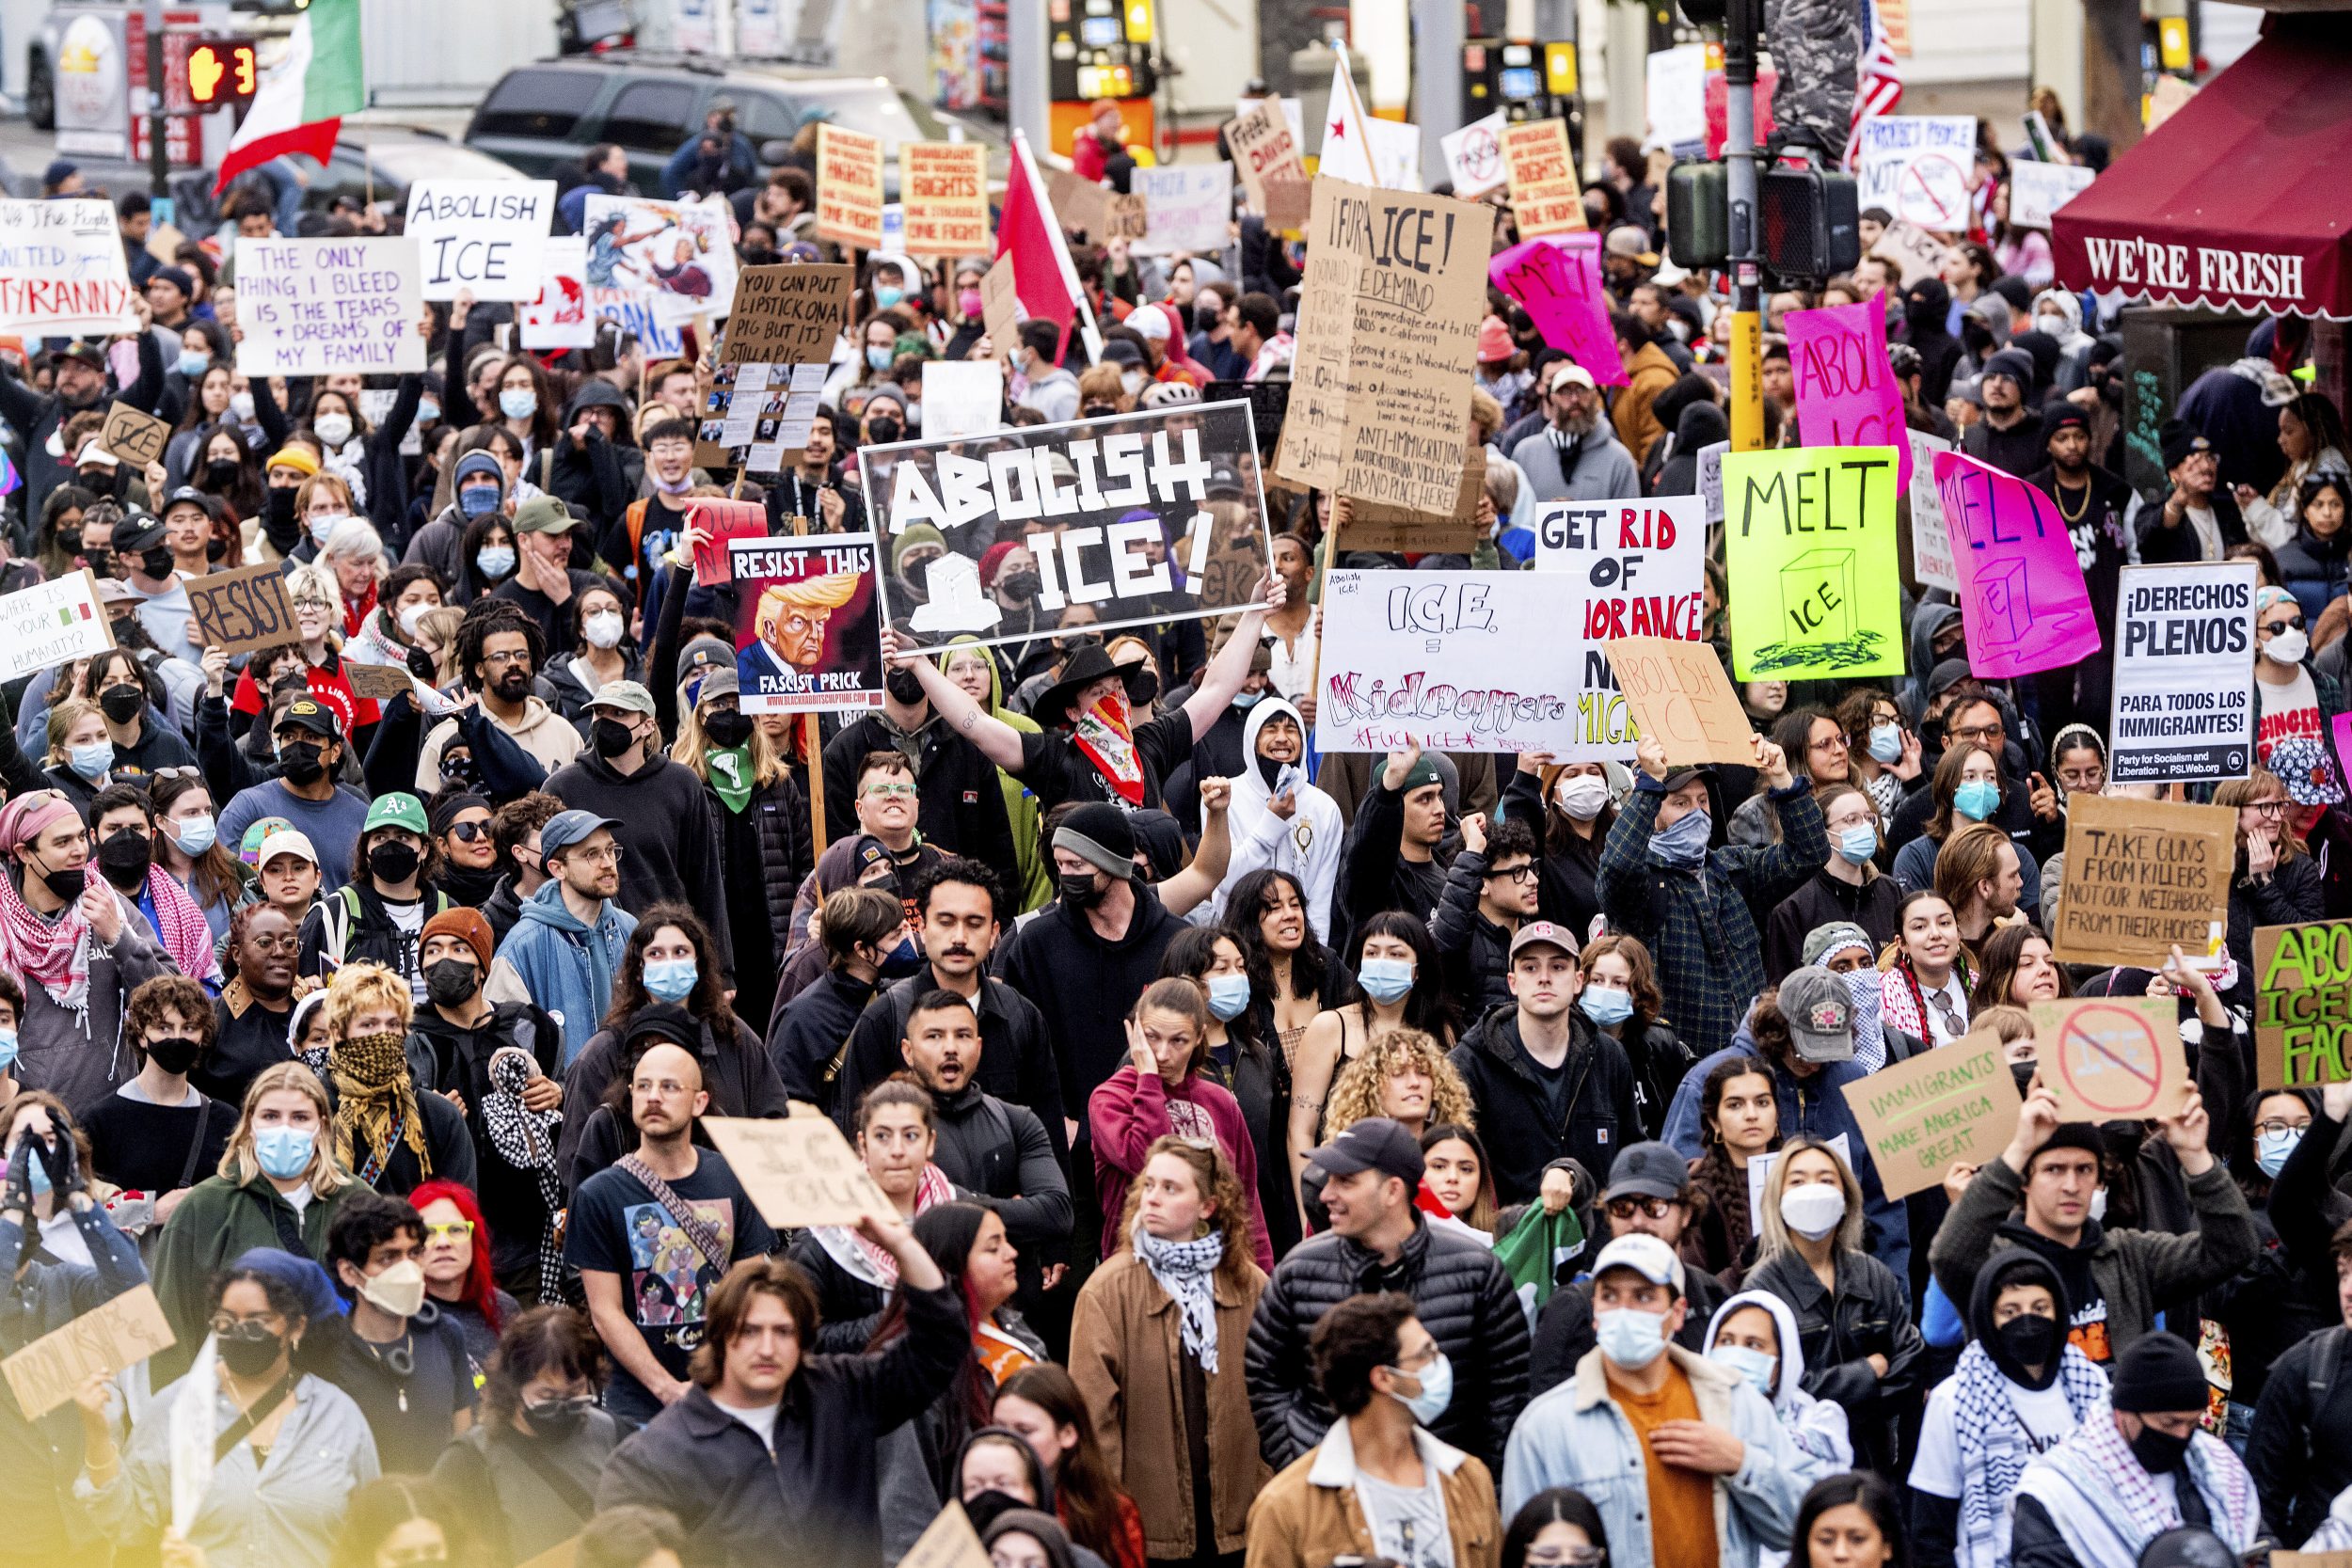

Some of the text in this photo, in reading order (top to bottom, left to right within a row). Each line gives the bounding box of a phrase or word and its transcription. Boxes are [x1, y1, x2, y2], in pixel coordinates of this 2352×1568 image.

[234, 47, 254, 93] 3
[912, 176, 977, 198] RIGHTS
[1865, 158, 1905, 197] NOT
[412, 191, 537, 223] ABOLISH
[255, 246, 366, 270] THE ONLY
[430, 236, 512, 284] ICE
[2084, 235, 2305, 299] WE'RE FRESH
[0, 277, 126, 314] TYRANNY
[238, 271, 401, 298] THING I BLEED
[744, 275, 841, 294] YOU CAN PUT
[1374, 268, 1435, 313] DEMAND
[256, 297, 401, 322] IS THE TEARS
[739, 296, 837, 323] LIPSTICK ON A
[1371, 306, 1479, 339] immediate end to ICE
[293, 321, 408, 341] DREAMS OF
[736, 320, 759, 338] PIG
[764, 321, 794, 340] BUT
[1390, 325, 1438, 346] California
[276, 341, 396, 367] MY FAMILY
[729, 342, 805, 362] STILL A PIG
[1377, 381, 1437, 404] Accountability
[114, 420, 162, 460] ICE
[1357, 426, 1463, 466] ANTI-IMMIGRATION
[888, 428, 1212, 534] ABOLISH
[1344, 468, 1454, 511] HAS NO PLACE HERE!
[1417, 464, 1457, 488] VIOLENCE
[1742, 460, 1889, 536] MELT
[1541, 508, 1677, 550] GET RID
[734, 547, 871, 578] RESIST THIS
[1589, 555, 1644, 591] OF
[44, 585, 65, 605] IS
[188, 570, 294, 646] RESIST
[1388, 583, 1499, 634] I.C.E.
[1789, 581, 1842, 635] ICE
[2127, 583, 2249, 618] ¡DERECHOS
[13, 611, 53, 638] YOUR
[2124, 616, 2248, 657] PLENOS
[11, 630, 86, 672] HUMANITY?
[759, 671, 862, 694] FASCIST PRICK
[1616, 656, 1719, 700] ABOLISH
[766, 692, 866, 706] WWW.BLACKRABBITSCULPTURE.COM
[1326, 671, 1566, 734] Kidnappers
[2120, 690, 2246, 713] PARA TODOS LOS
[1637, 697, 1730, 746] ICE
[2119, 713, 2244, 737] INMIGRANTES!
[2117, 763, 2219, 777] Liberation PSLWeb.org
[2118, 751, 2209, 768] Party for Socialism and
[2085, 830, 2206, 863] TAKE GUNS
[2082, 858, 2207, 889] FROM KILLERS
[2069, 882, 2215, 913] NOT OUR NEIGHBORS
[2067, 911, 2209, 942] FROM THEIR HOMES
[2068, 1028, 2149, 1077] ICE
[1868, 1051, 1996, 1119] IMMIGRANTS
[1877, 1126, 1921, 1160] MAKE
[1916, 1128, 1976, 1169] GREAT
